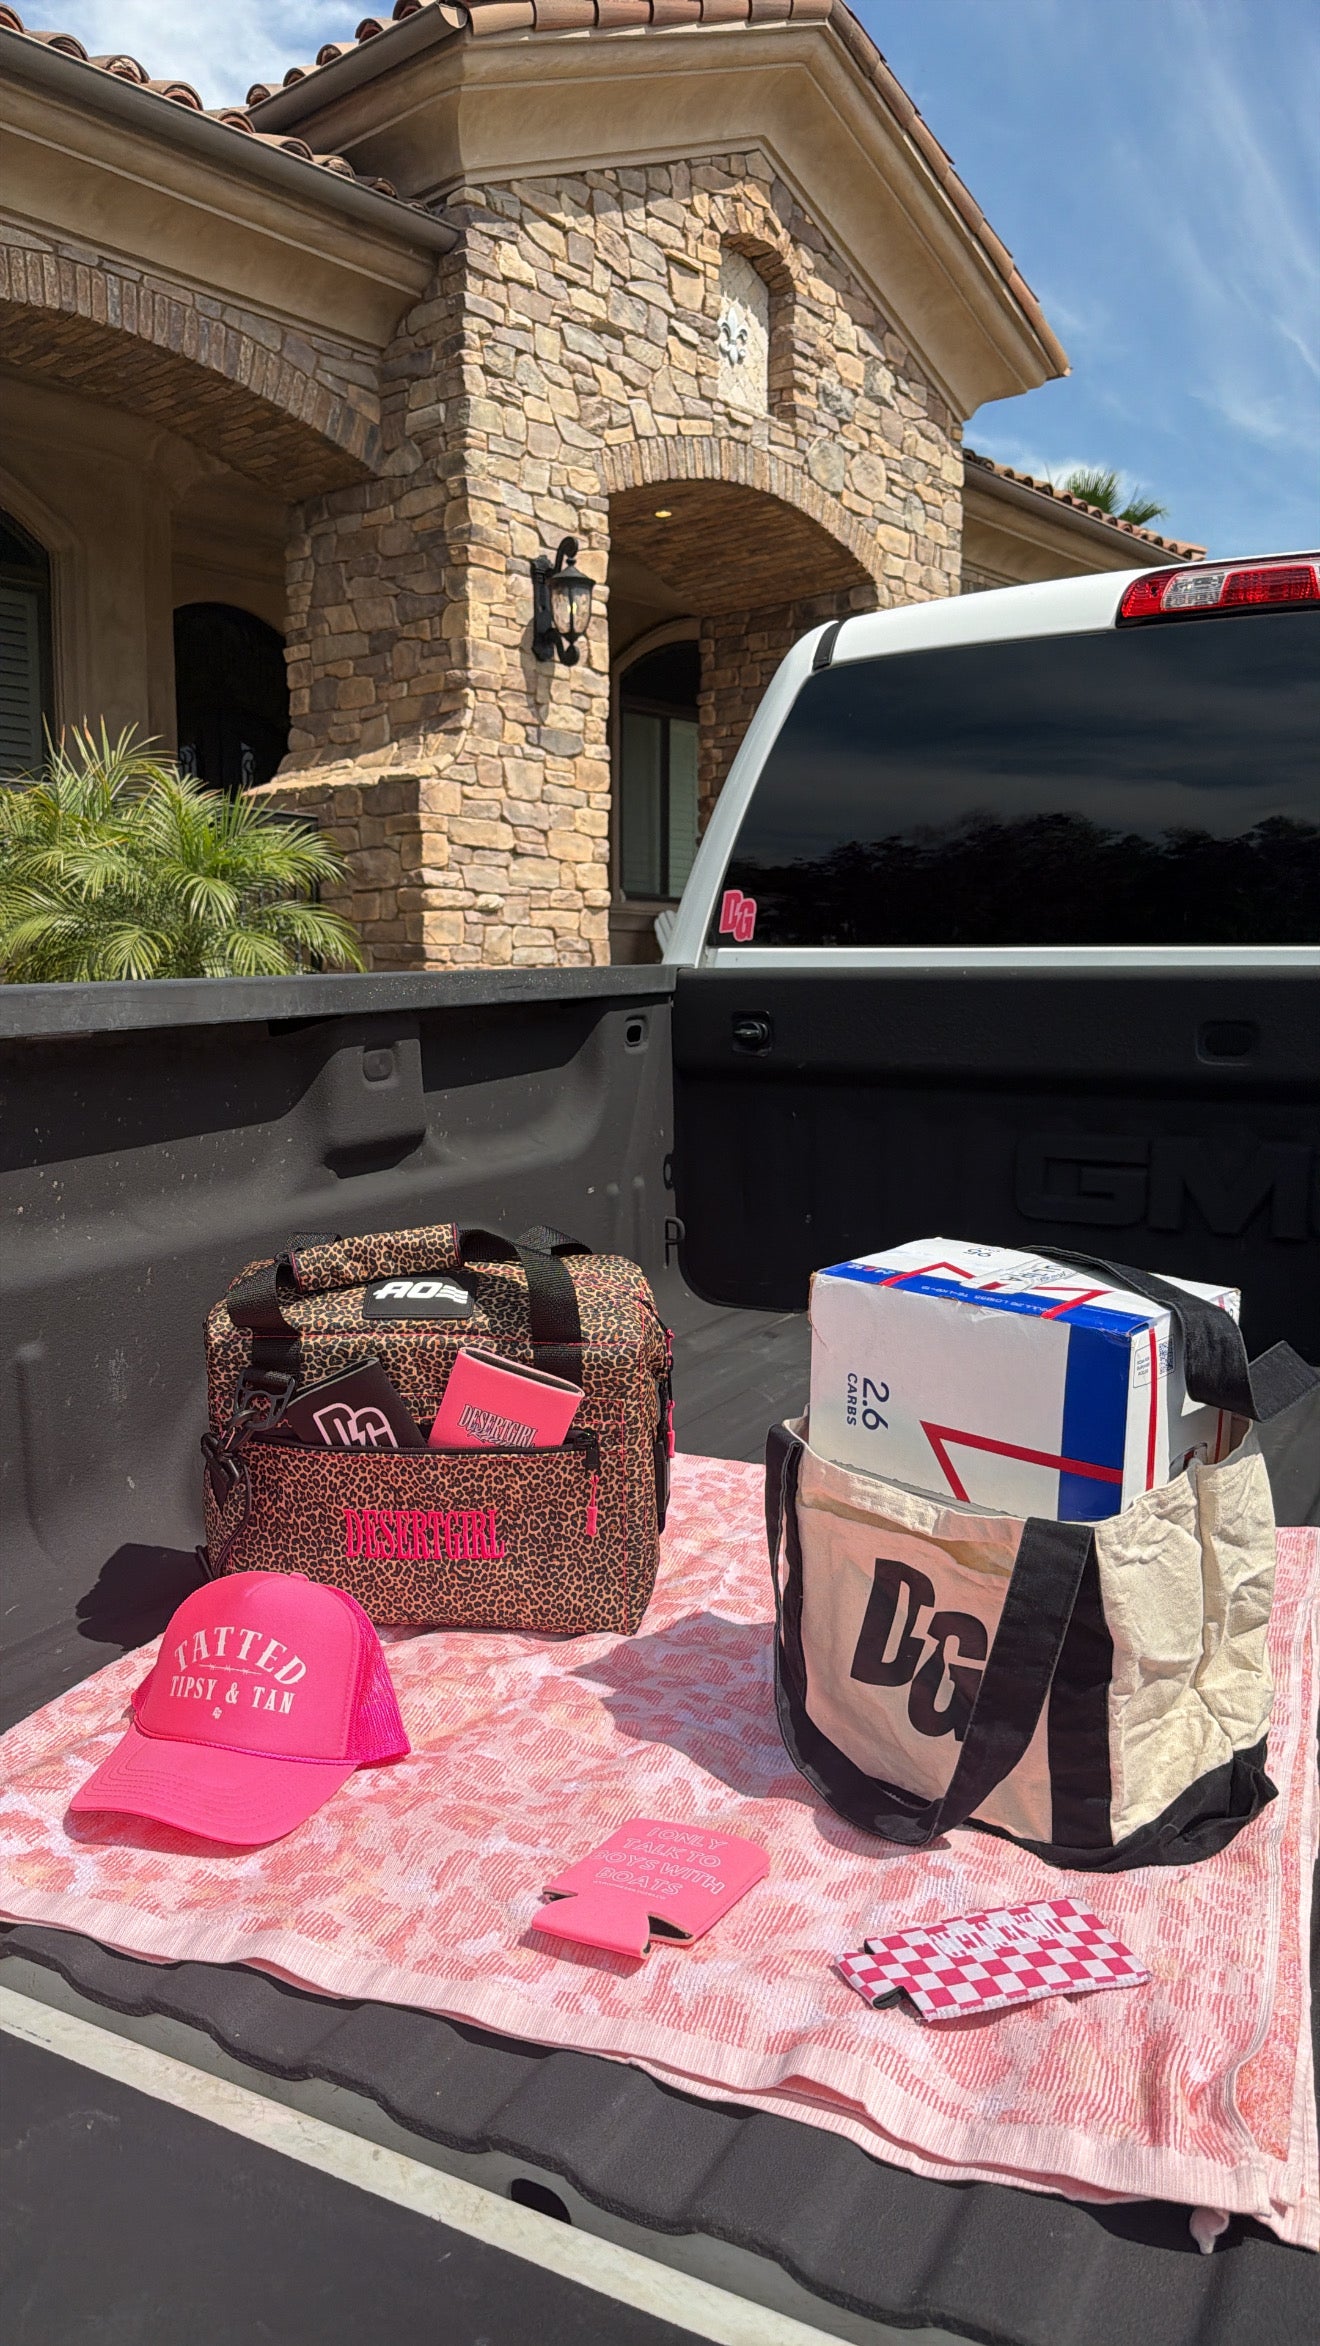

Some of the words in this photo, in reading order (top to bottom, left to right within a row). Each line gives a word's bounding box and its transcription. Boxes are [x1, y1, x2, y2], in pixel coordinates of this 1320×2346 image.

[719, 890, 757, 942] DG
[1014, 1132, 1320, 1242] GM
[846, 1372, 858, 1426] CARBS
[862, 1377, 890, 1431] 2.6
[458, 1403, 538, 1448] DESERTGIRL
[343, 1509, 505, 1560] DESERTGIRL
[174, 1626, 307, 1685] TATTED
[850, 1557, 988, 1742] DG
[169, 1675, 218, 1700] TIPSY
[225, 1682, 240, 1704] &
[252, 1686, 296, 1714] TAN
[623, 1837, 688, 1860] TALK
[686, 1850, 721, 1868] TO
[646, 1827, 661, 1838] I
[657, 1829, 728, 1850] ONLY
[591, 1851, 660, 1871] BOYS
[659, 1862, 726, 1895] WITH
[595, 1866, 684, 1896] BOATS
